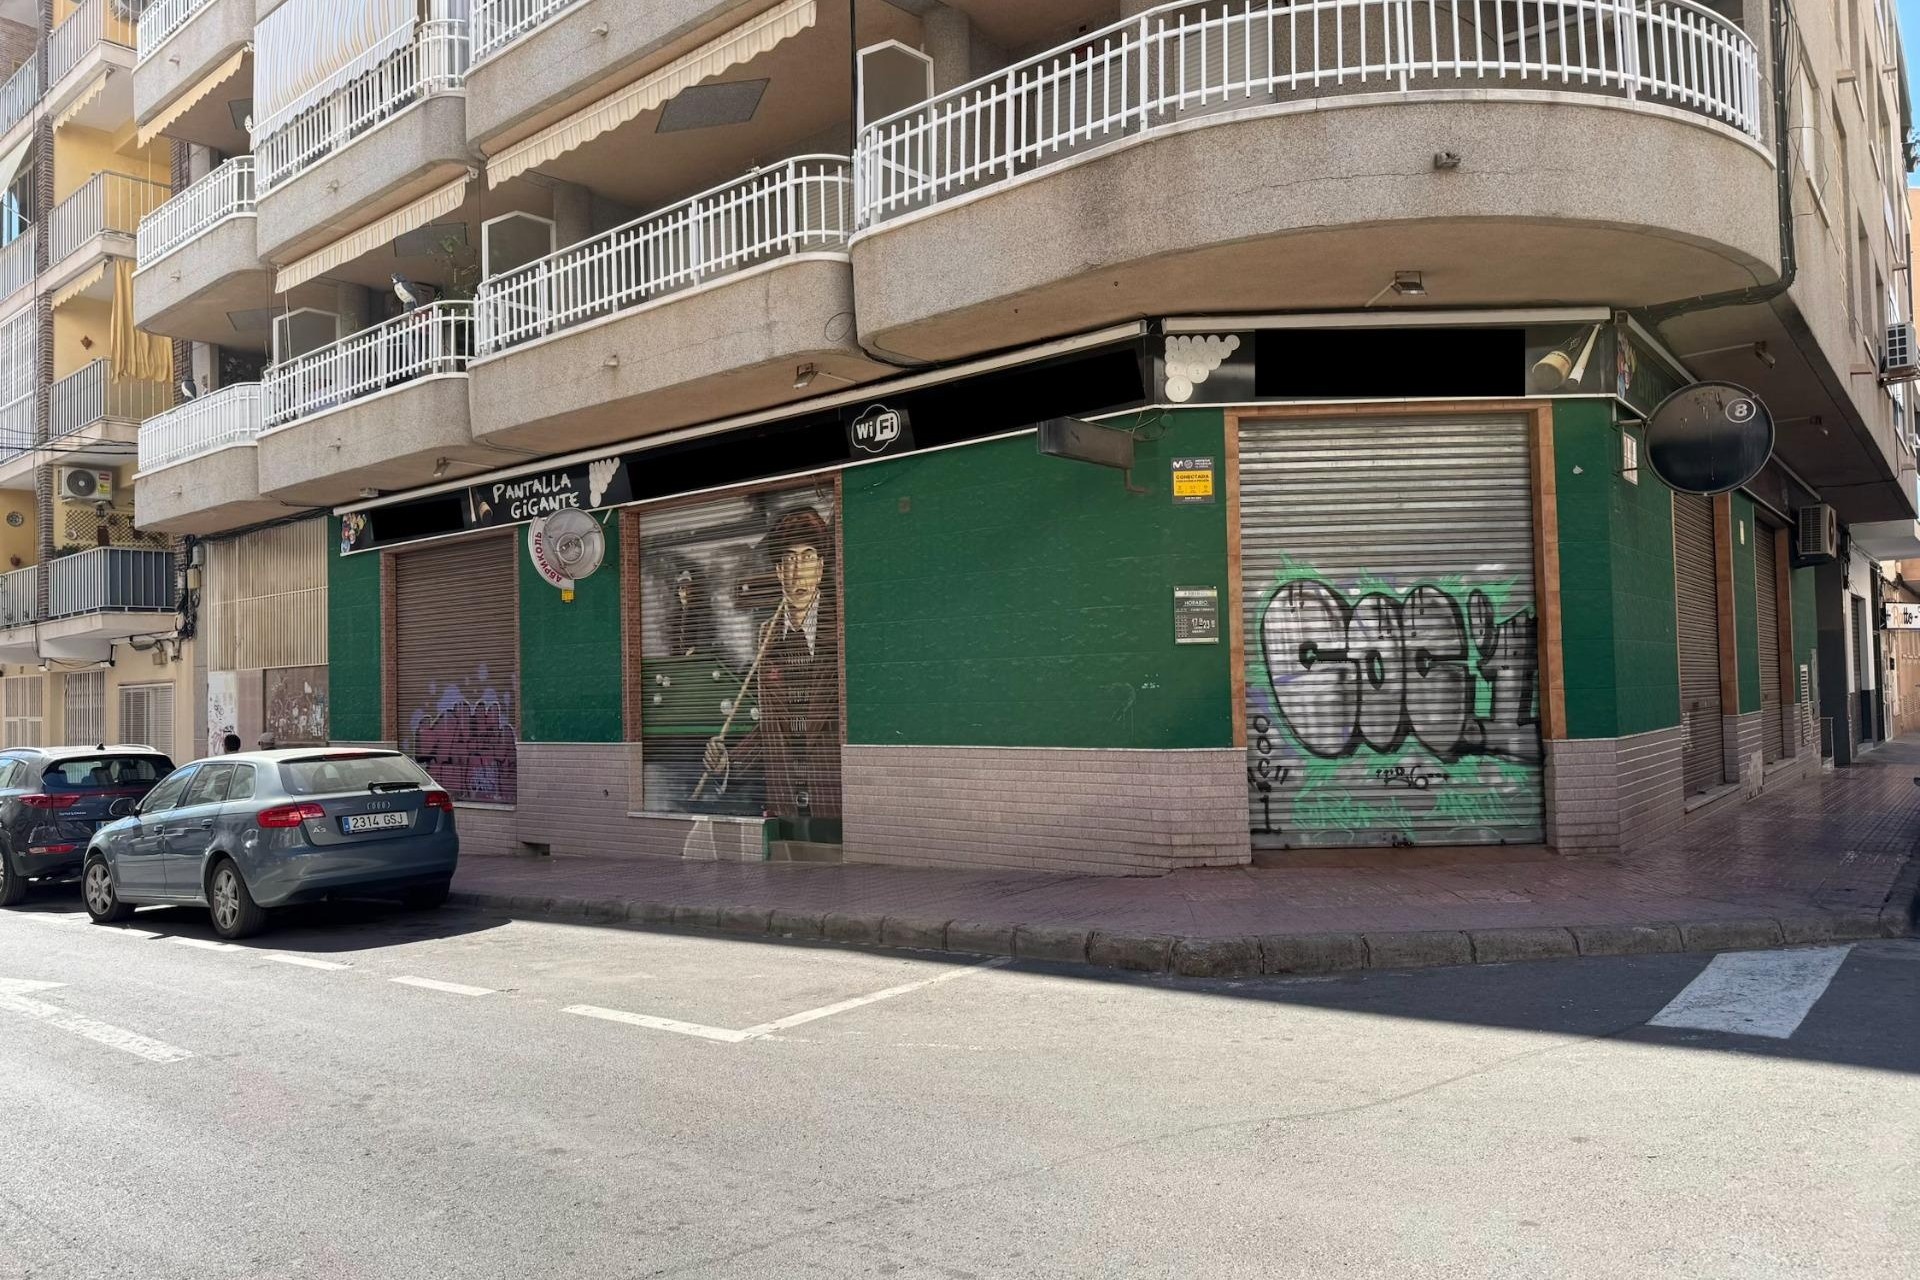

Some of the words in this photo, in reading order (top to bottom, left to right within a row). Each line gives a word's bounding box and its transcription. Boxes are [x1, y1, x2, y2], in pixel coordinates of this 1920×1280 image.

[1734, 403, 1748, 417] 8
[493, 473, 572, 504] PANTALLA
[352, 816, 379, 829] 2314
[383, 813, 403, 825] GSJ
